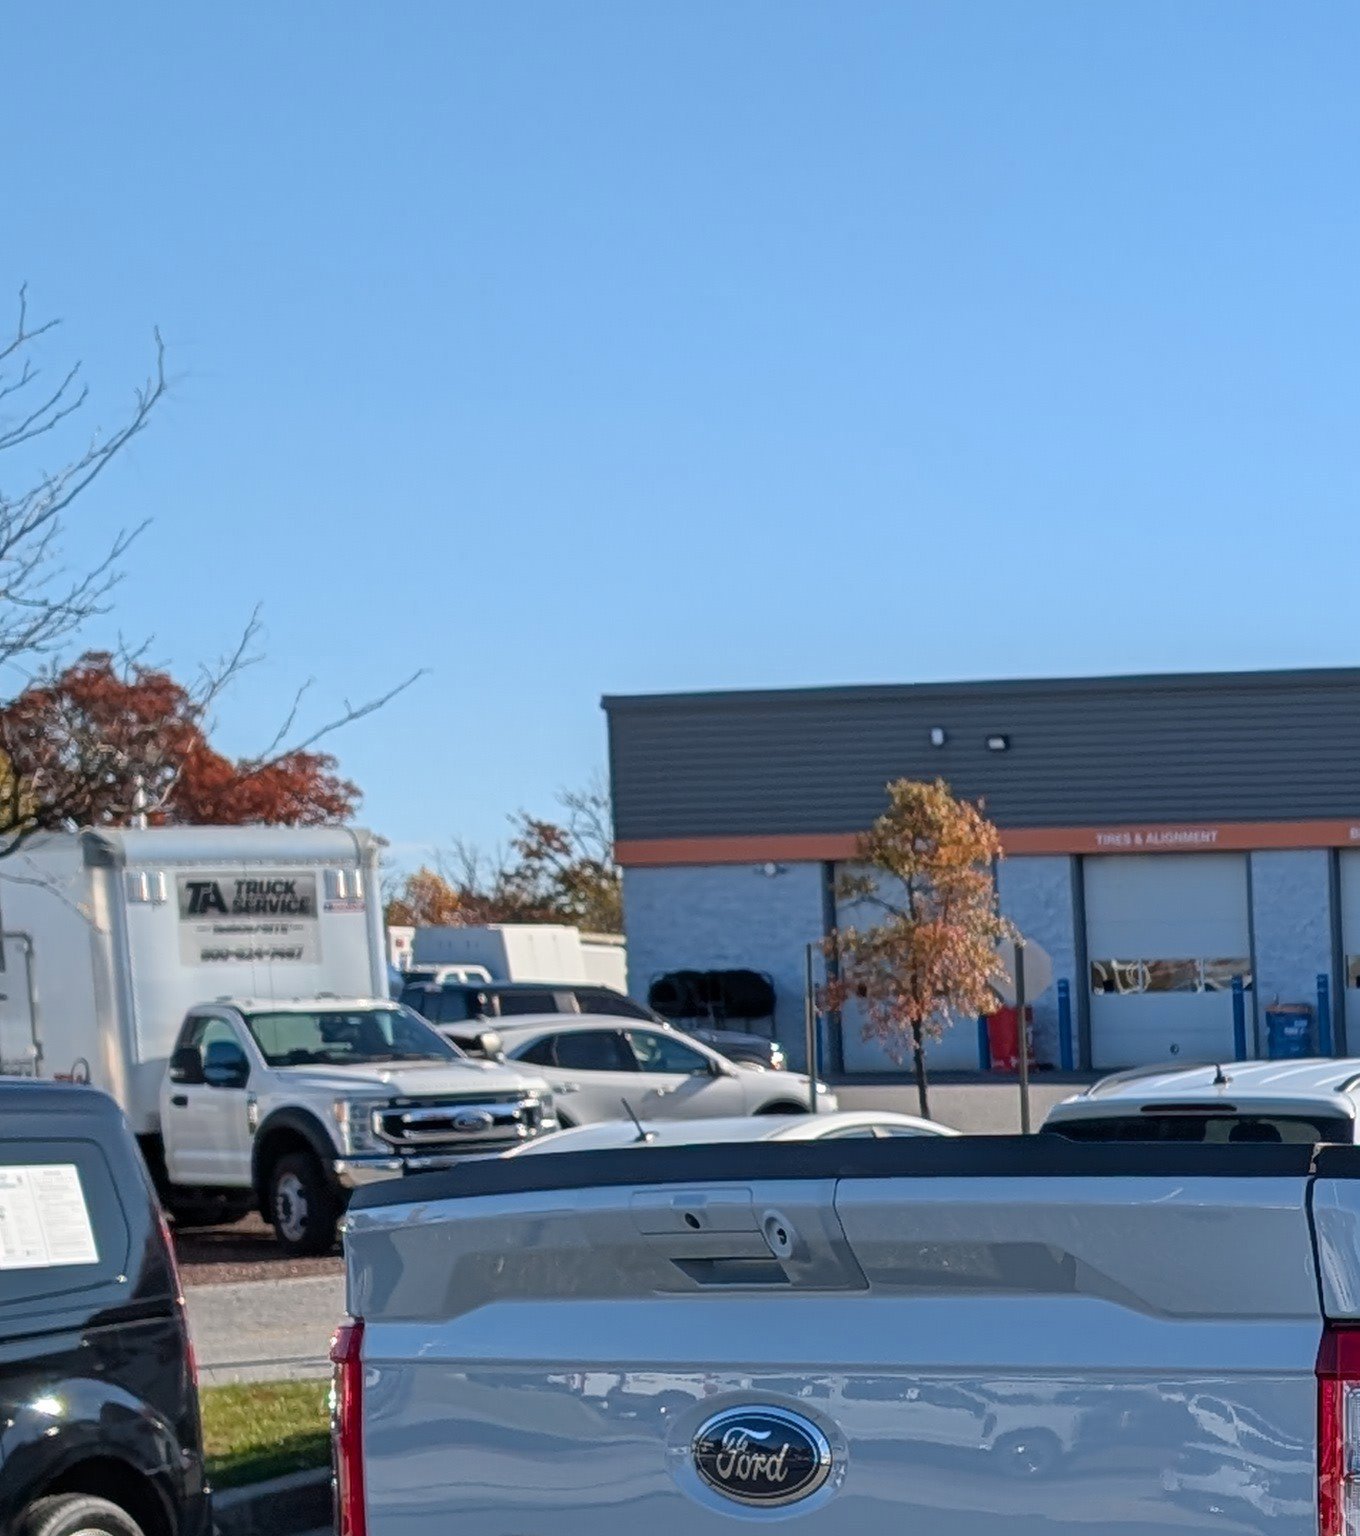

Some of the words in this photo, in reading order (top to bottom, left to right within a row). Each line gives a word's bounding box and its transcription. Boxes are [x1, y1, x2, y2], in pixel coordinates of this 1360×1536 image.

[1096, 832, 1132, 845] TIRES
[1134, 832, 1143, 845] &
[1145, 830, 1218, 844] ALIGNMENT
[186, 879, 229, 914] TA
[234, 879, 297, 896] TRUCK
[232, 895, 311, 914] SERVICE
[716, 1427, 789, 1482] Ford
